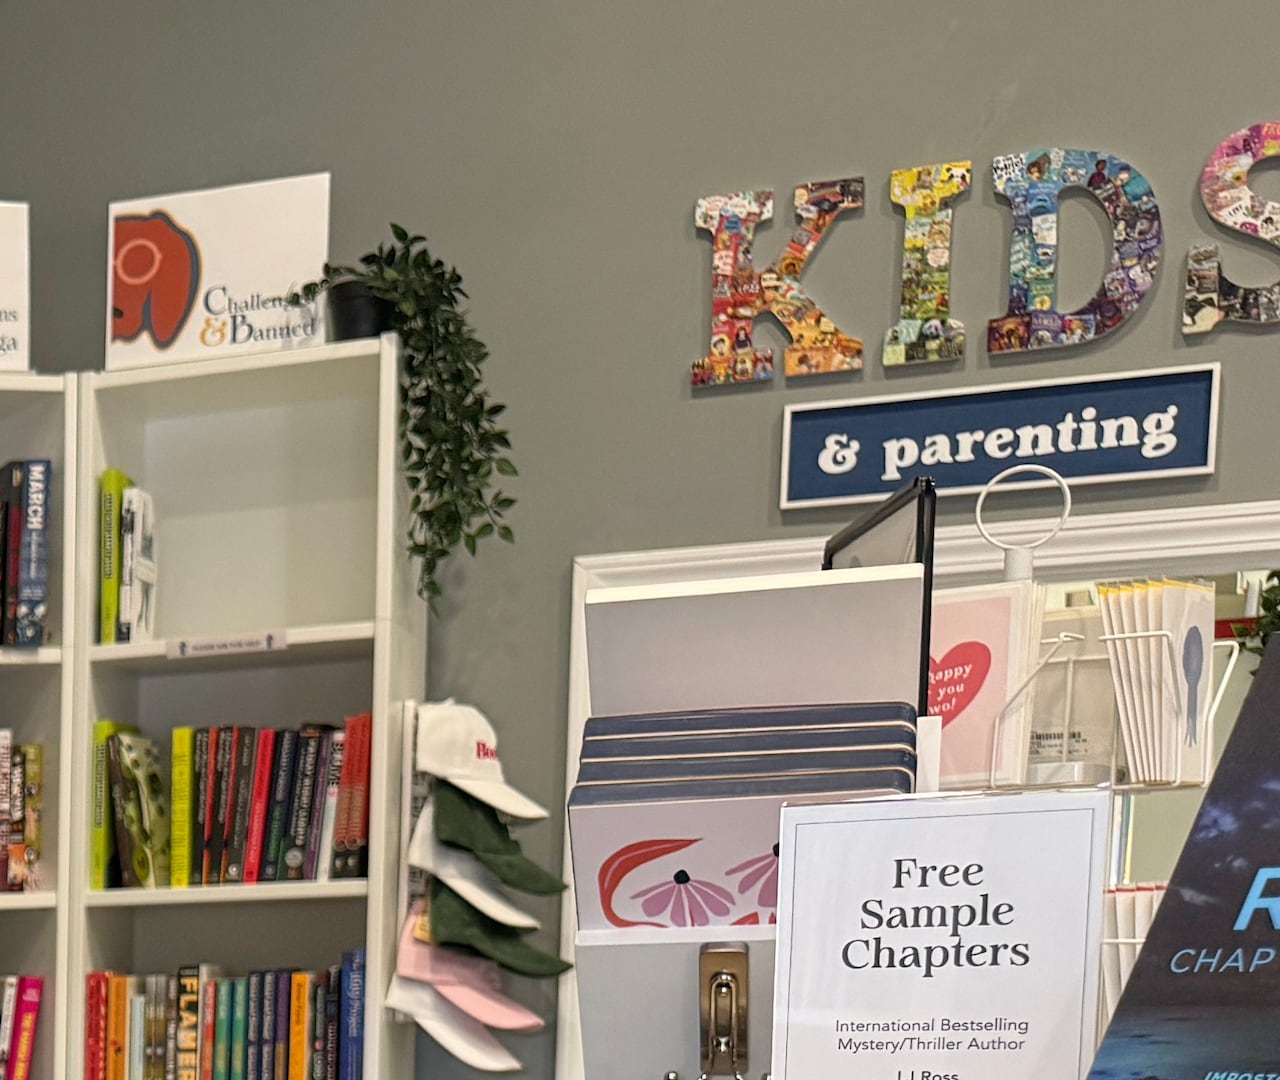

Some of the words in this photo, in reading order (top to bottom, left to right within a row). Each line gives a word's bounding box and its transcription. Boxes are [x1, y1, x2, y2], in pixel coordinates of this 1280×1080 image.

[691, 120, 1280, 387] KIDS
[200, 318, 227, 347] &
[229, 315, 317, 346] Banned
[818, 433, 860, 475] &
[881, 405, 1178, 481] parenting
[26, 462, 45, 532] MARCH
[937, 683, 965, 700] you
[892, 857, 984, 890] Free
[859, 894, 1014, 937] Sample
[840, 936, 1030, 977] Chapters
[834, 1017, 936, 1034] International
[941, 1017, 1029, 1035] Bestselling
[837, 1036, 962, 1053] Mystery/Thriller
[967, 1036, 1026, 1051] Author
